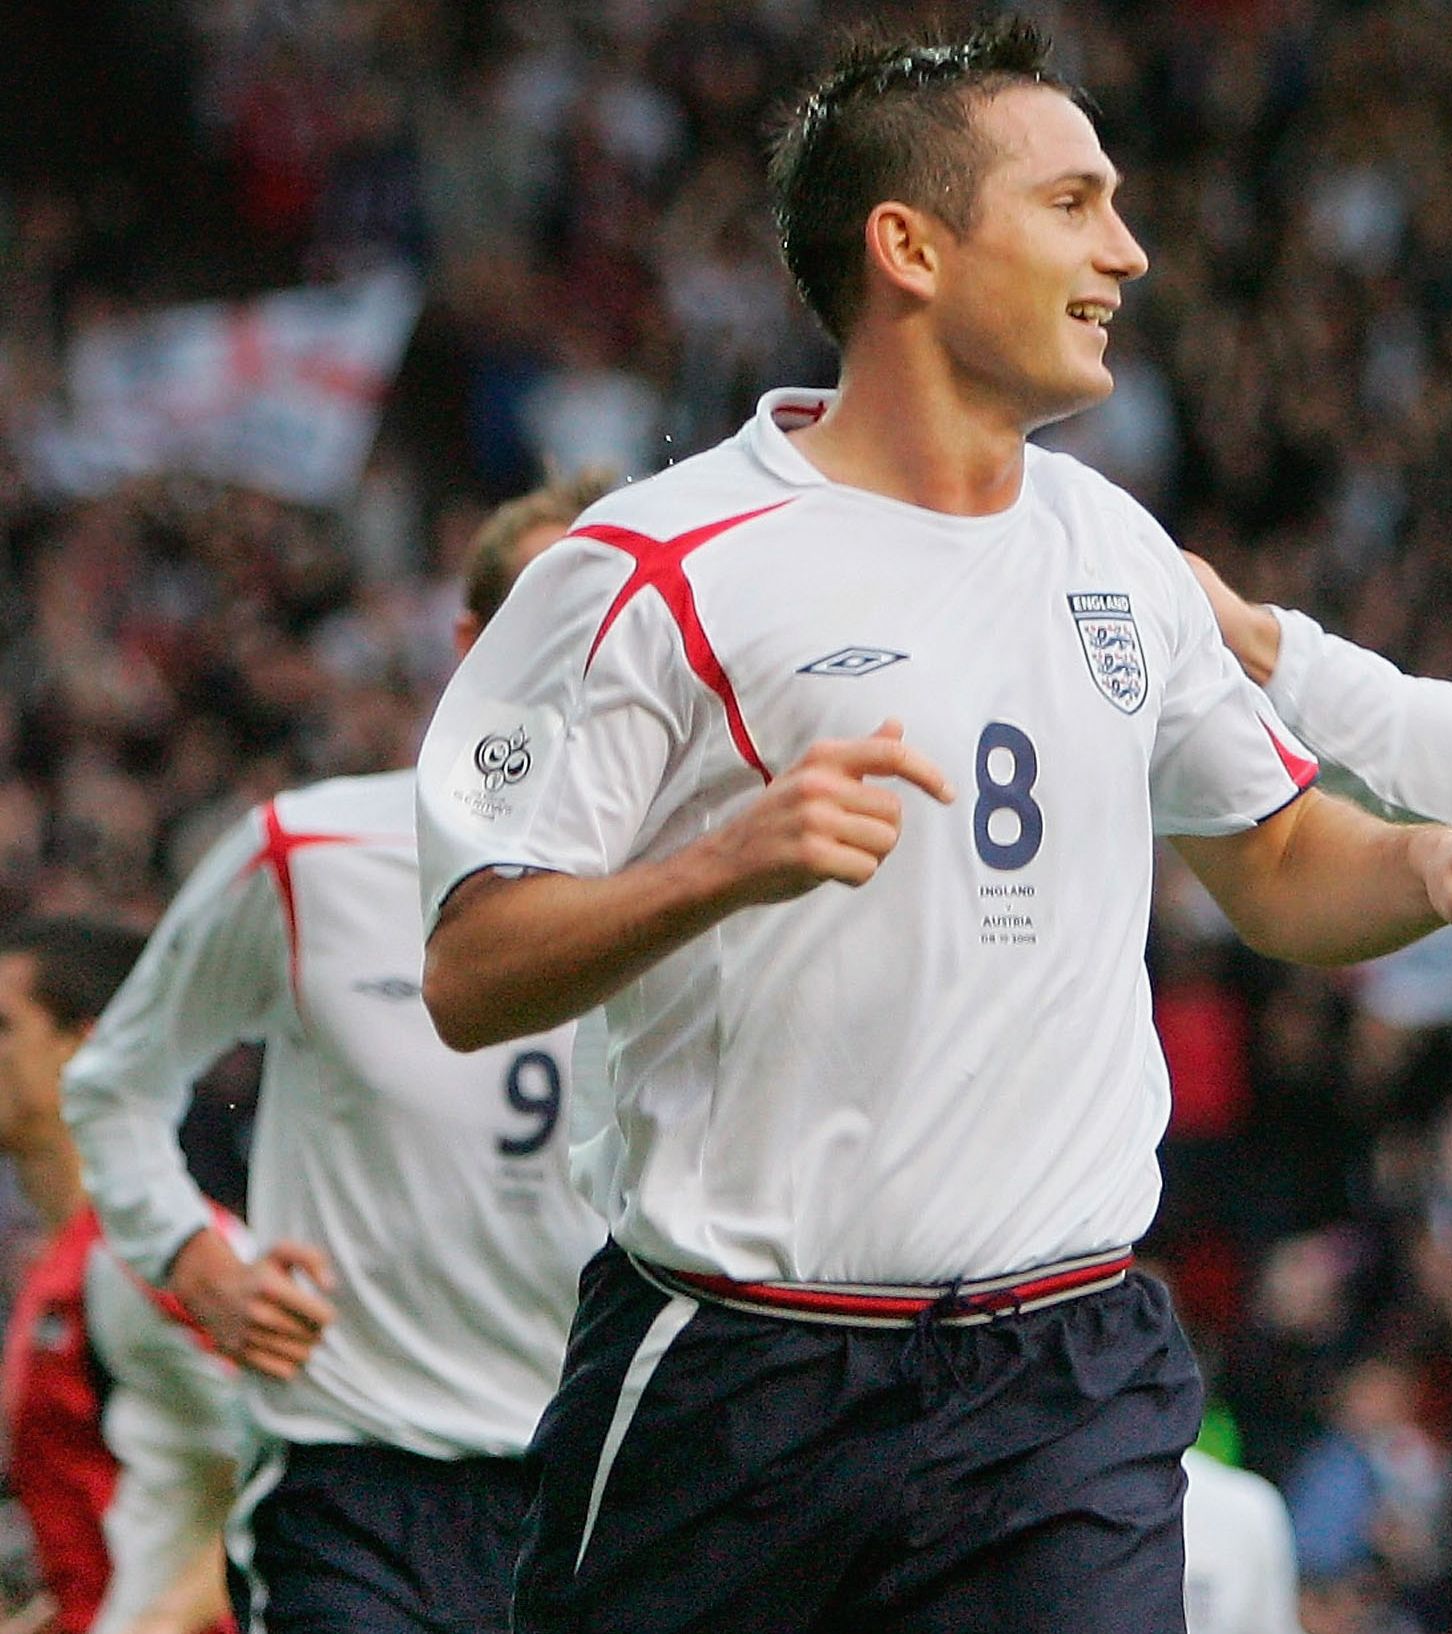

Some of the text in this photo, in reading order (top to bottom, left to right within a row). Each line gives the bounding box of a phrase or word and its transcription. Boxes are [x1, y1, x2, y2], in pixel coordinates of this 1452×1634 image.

[1072, 594, 1129, 612] ENGLAND
[973, 721, 1043, 871] 8
[980, 885, 1035, 896] ENGLAND
[982, 916, 1033, 928] AUSTRIA
[496, 1051, 561, 1156] 9
